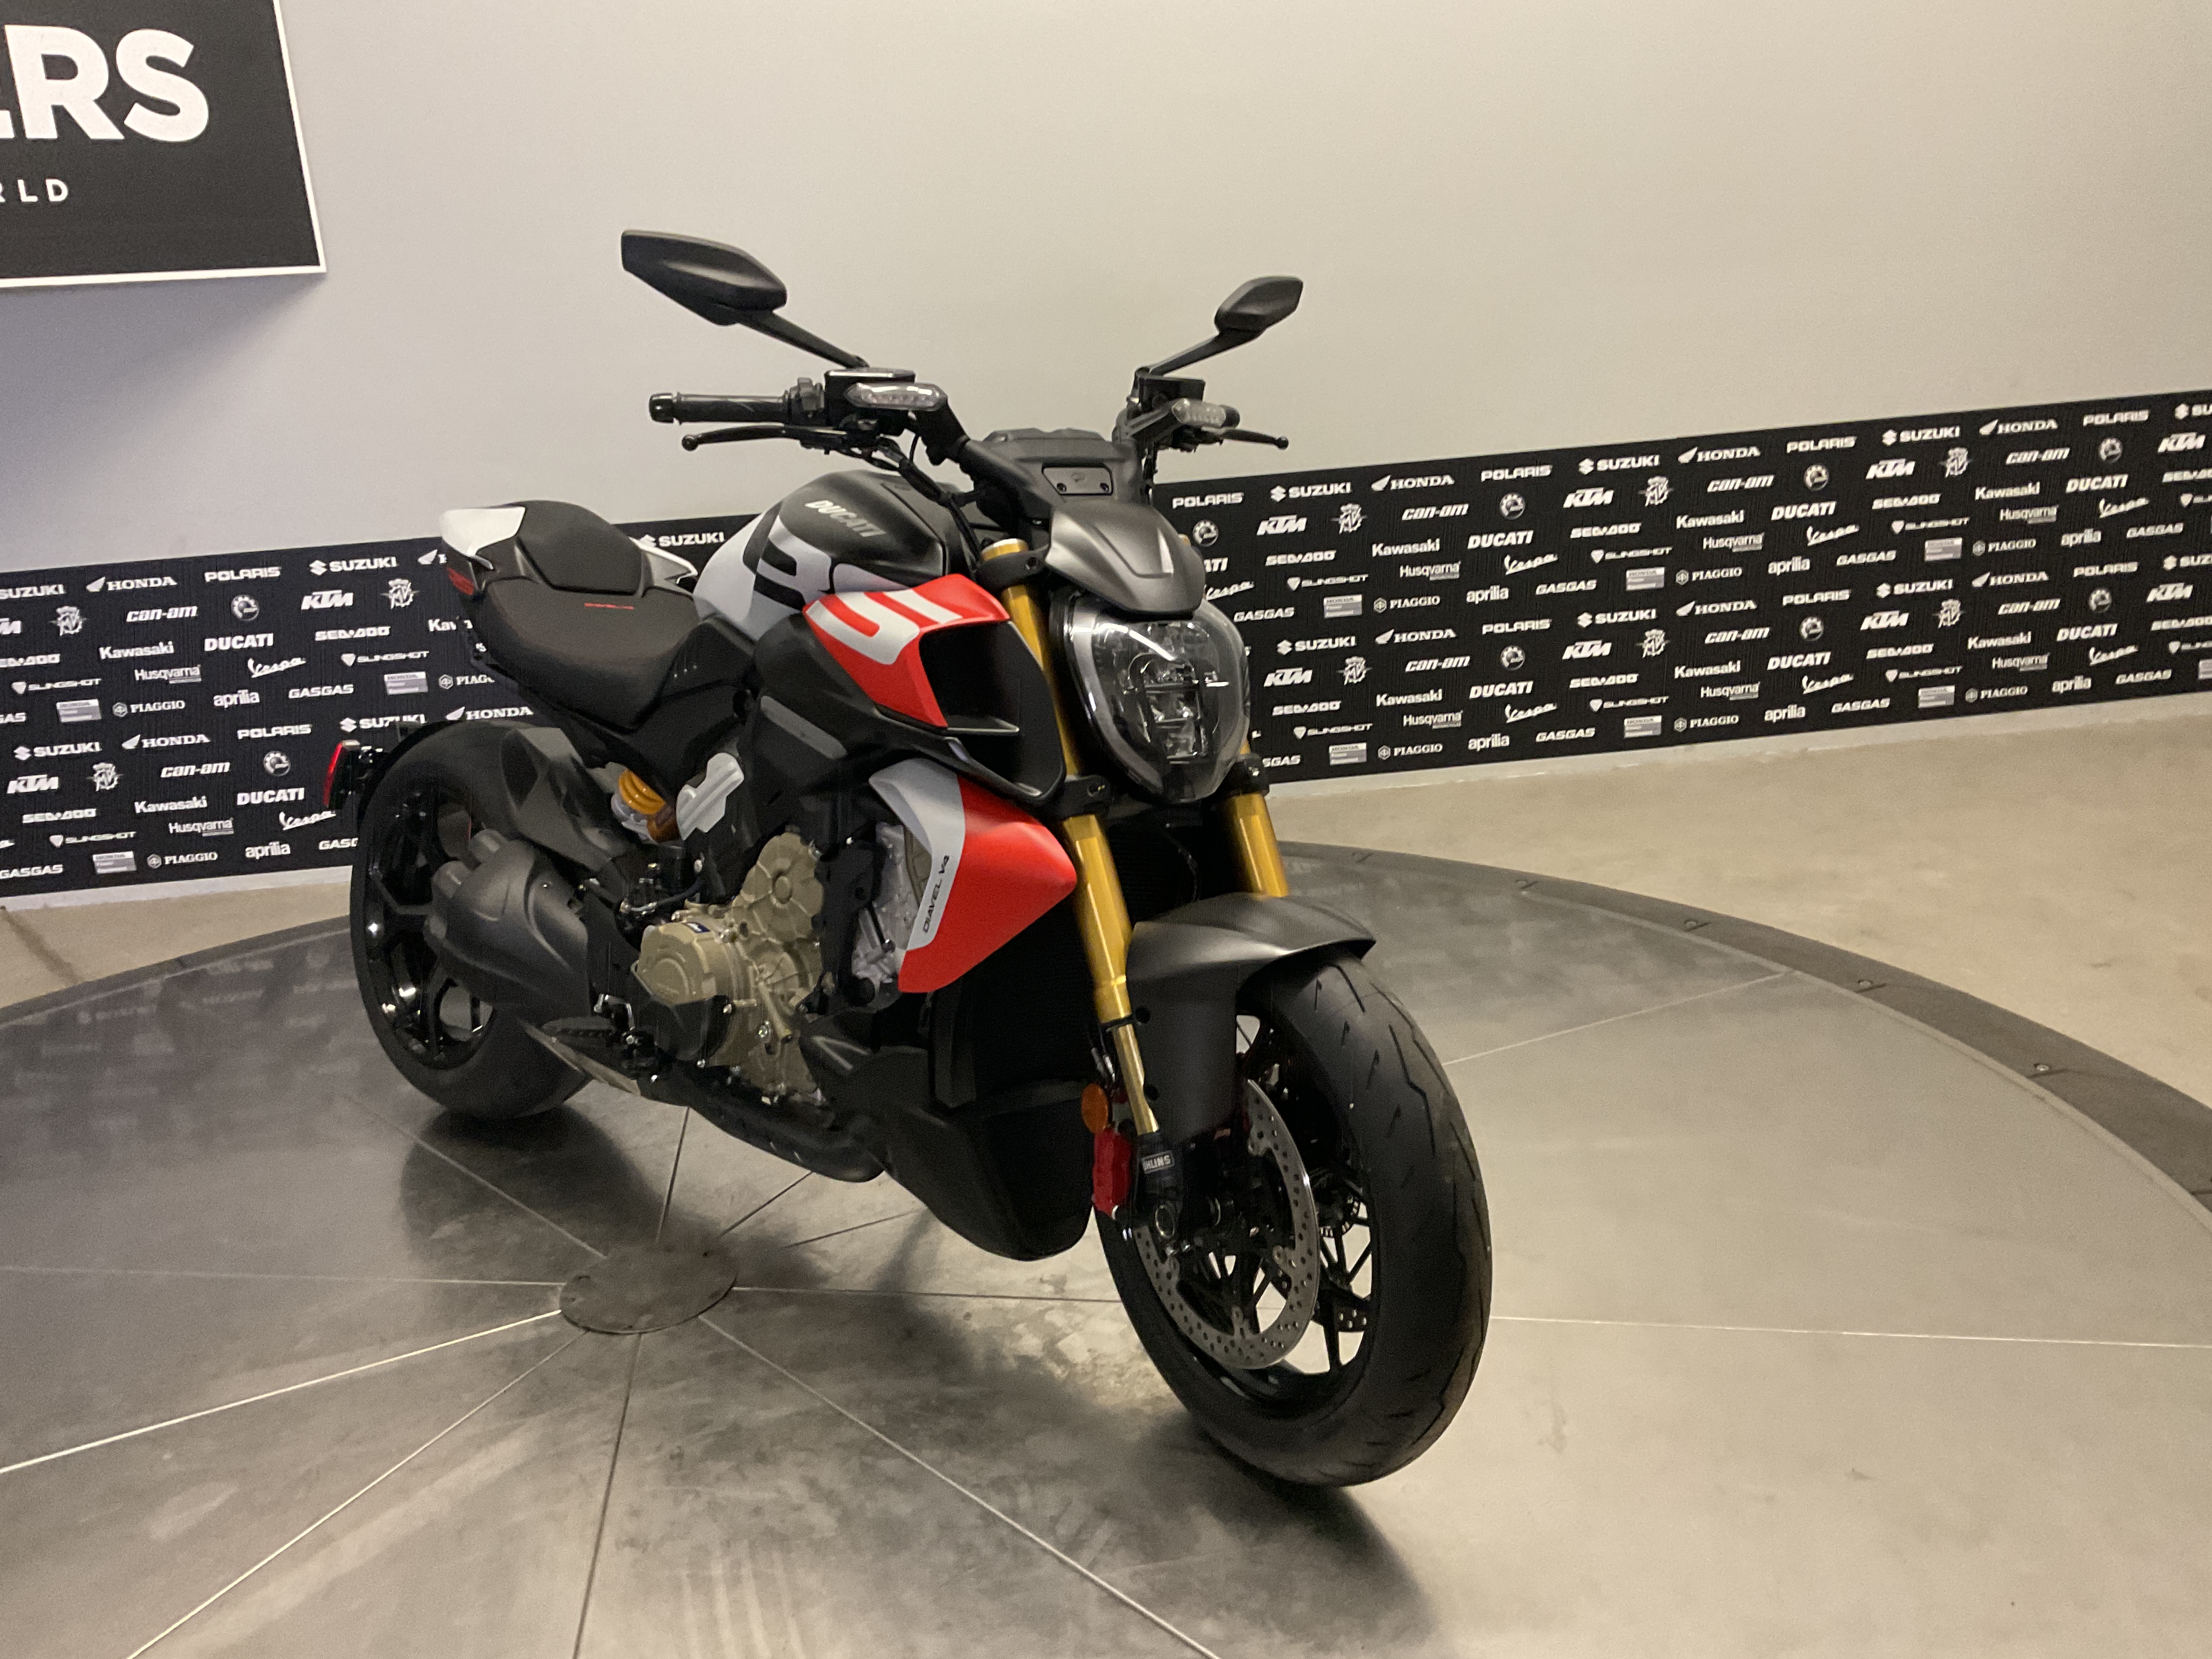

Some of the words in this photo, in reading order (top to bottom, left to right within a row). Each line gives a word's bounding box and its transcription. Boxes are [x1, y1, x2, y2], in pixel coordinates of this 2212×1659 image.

[0, 25, 209, 142] RS
[1900, 426, 1960, 442] SUZUKI
[1998, 419, 2058, 434] HONDA
[1787, 437, 1857, 453] POLARIS
[1697, 447, 1760, 461] HONDA
[1597, 455, 1660, 471] SUZUKI
[1866, 459, 1915, 479] KTM
[1481, 465, 1552, 482] POLARIS
[1289, 482, 1351, 498] SUZUKI
[1391, 475, 1454, 489] HONDA
[2066, 474, 2128, 493] DUCATI
[1564, 487, 1613, 508] KTM
[1975, 482, 2040, 500] Kawasaki
[1172, 493, 1244, 508] POLARIS
[804, 500, 887, 537] DUCATI
[1771, 501, 1836, 520] DUCATI
[2000, 505, 2058, 521] Husqvarna
[1257, 515, 1307, 535] KTM
[1677, 510, 1744, 529] Kawasaki
[658, 531, 725, 547] SUZUKI
[1468, 530, 1533, 549] DUCATI
[1703, 533, 1764, 550] Husqvarna
[1988, 539, 2036, 552] PIAGGIO
[2061, 528, 2101, 547] aprilia
[1372, 538, 1440, 557] Kawasaki
[329, 557, 398, 572] SUZUKI
[1768, 556, 1810, 575] aprilia
[1837, 550, 1896, 566] GASGAS
[205, 567, 281, 582] POLARIS
[1400, 561, 1460, 578] Husqvarna
[1692, 567, 1742, 581] PIAGGIO
[106, 577, 177, 590] HONDA
[1894, 579, 1953, 594] SUZUKI
[1990, 572, 2049, 585] HONDA
[0, 584, 65, 599] SUZUKI
[1466, 585, 1509, 604] aprilia
[1536, 580, 1596, 595] GASGAS
[301, 590, 353, 610] KTM
[1390, 596, 1440, 608] PIAGGIO
[1783, 590, 1850, 606] POLARIS
[1233, 607, 1295, 622] GASGAS
[1695, 600, 1757, 614] HONDA
[1595, 609, 1656, 624] SUZUKI
[1860, 611, 1909, 630] KTM
[1482, 619, 1551, 634] POLARIS
[2057, 624, 2118, 641] DUCATI
[204, 633, 273, 651] DUCATI
[1295, 636, 1356, 651] SUZUKI
[1394, 629, 1456, 642] HONDA
[1968, 631, 2031, 649] Kawasaki
[99, 641, 174, 659] Kawasaki
[1562, 640, 1612, 659] KTM
[1767, 652, 1831, 670] DUCATI
[1993, 654, 2049, 668] Husqvarna
[134, 664, 201, 681] Husqvarna
[1264, 668, 1312, 686] KTM
[1674, 661, 1740, 679] Kawasaki
[456, 674, 495, 685] PIAG
[2052, 675, 2091, 693] aprilia
[289, 684, 354, 698] GASGAS
[1469, 681, 1533, 698] DUCATI
[1701, 682, 1760, 697] Husqvarna
[1980, 686, 2028, 698] PIAGGIO
[213, 690, 259, 708] aprilia
[1376, 689, 1442, 707] Kawasaki
[1831, 698, 1890, 713] GASGAS
[131, 701, 185, 713] PIAGGIO
[466, 707, 534, 720] HONDA
[1764, 704, 1805, 723] aprilia
[1403, 710, 1463, 726] Husqvarna
[1690, 715, 1739, 728] PIAGGIO
[237, 724, 312, 739] POLARIS
[1536, 728, 1595, 742] GASGAS
[142, 734, 210, 748] HONDA
[1468, 733, 1509, 751] aprilia
[33, 742, 102, 757] SUZUKI
[1394, 744, 1442, 756] PIAGGIO
[7, 774, 59, 794] KTM
[134, 795, 207, 813] Kawasaki
[237, 788, 304, 805] DUCATI
[168, 818, 234, 833] Husqvarna
[164, 852, 218, 864] PIAGGIO
[245, 842, 290, 859] aprilia
[0, 865, 63, 879] GASGAS
